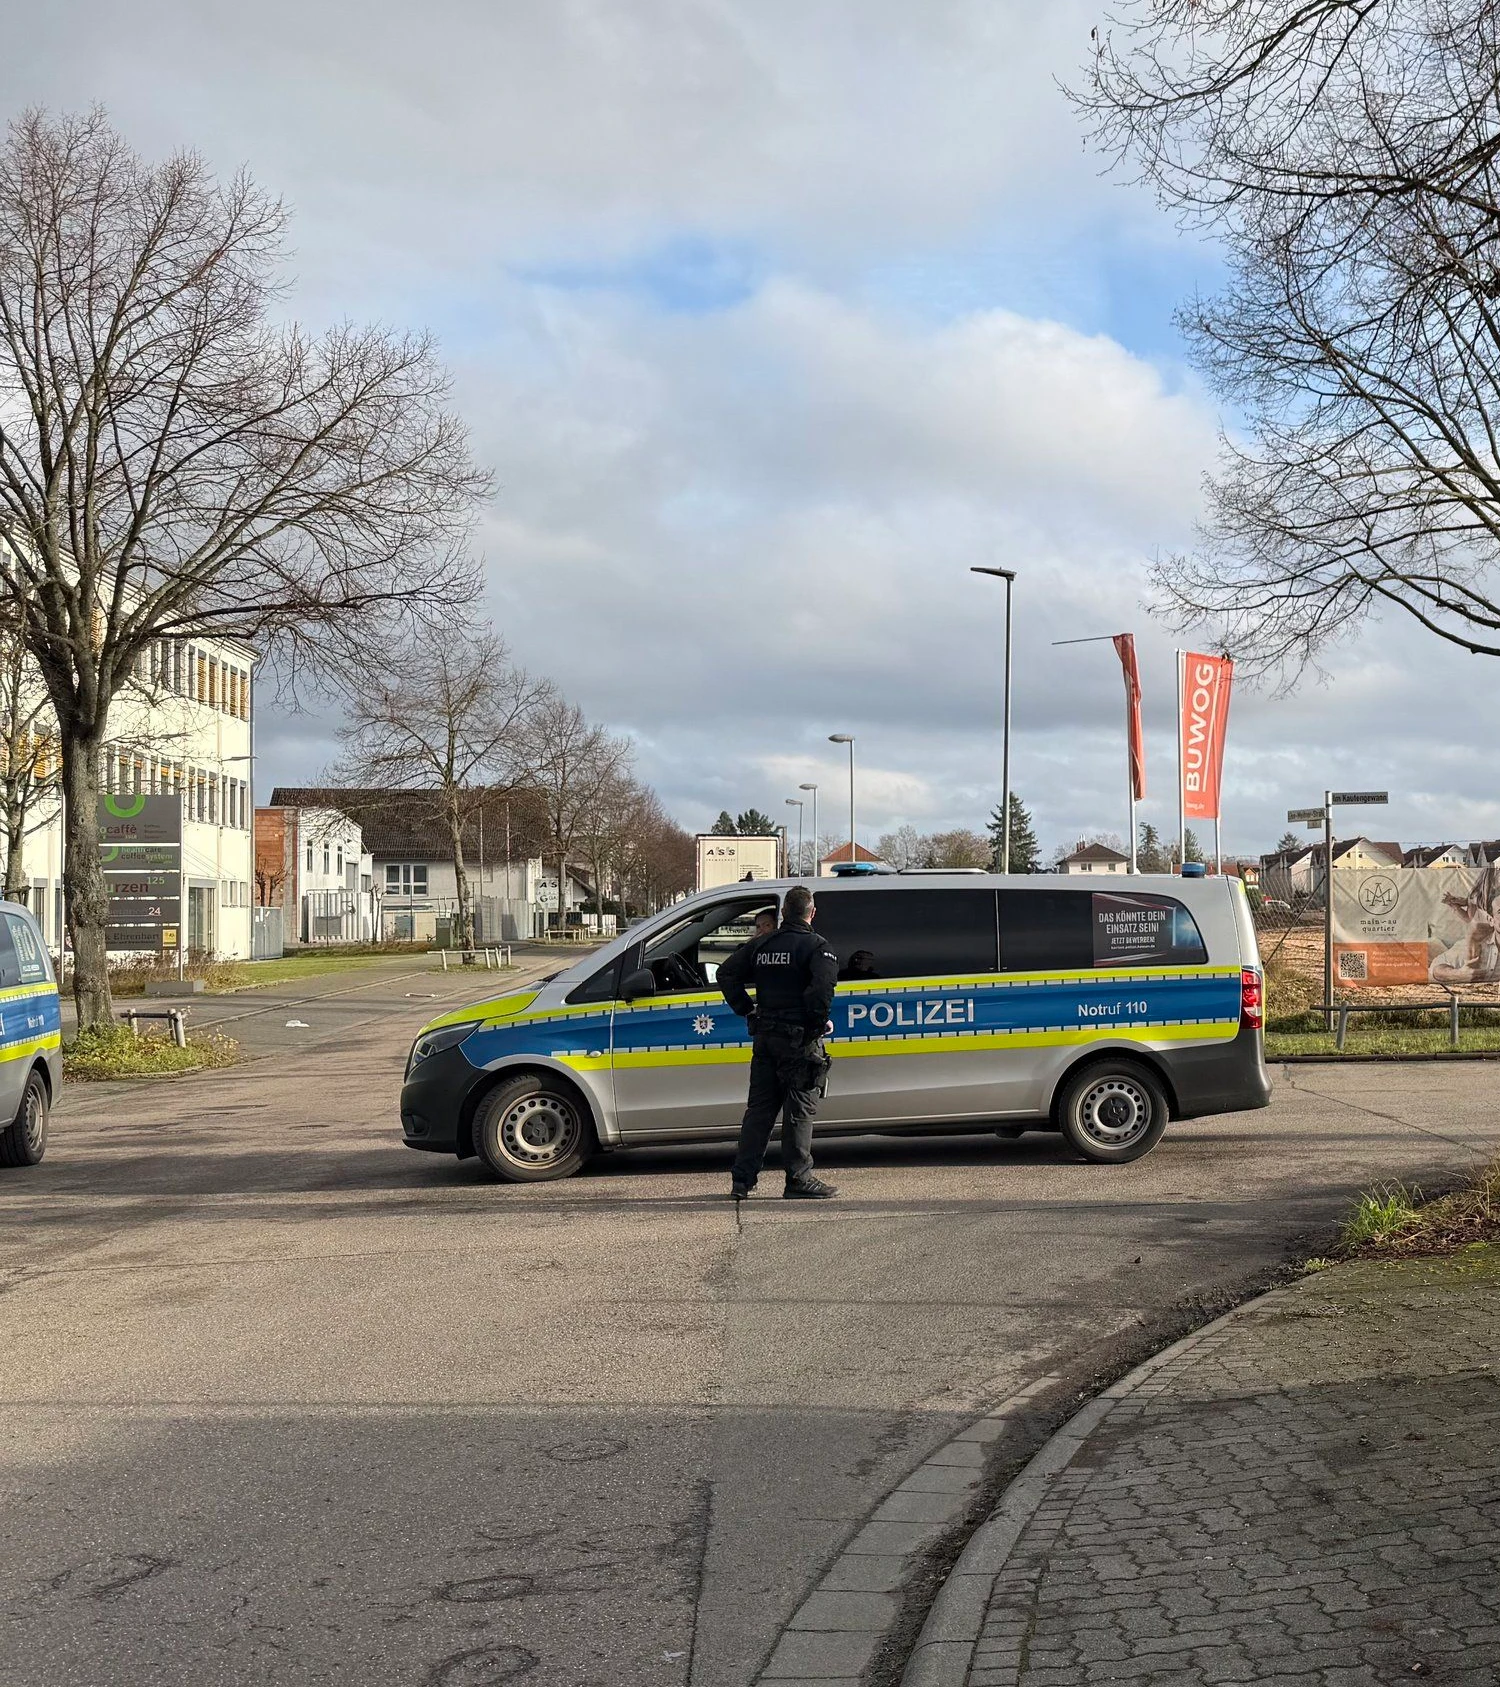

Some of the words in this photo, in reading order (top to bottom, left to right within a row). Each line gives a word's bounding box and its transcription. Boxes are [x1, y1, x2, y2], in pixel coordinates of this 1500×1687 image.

[1186, 663, 1214, 791] BUWOG
[105, 883, 148, 893] urzen
[147, 877, 165, 885] 125
[148, 907, 161, 916] 24
[1098, 913, 1114, 922] DAS
[1115, 910, 1146, 922] KÖNNTE
[1148, 911, 1166, 921] DEIN
[1106, 923, 1137, 934] EINSATZ
[1139, 922, 1159, 932] SEIN!
[1111, 937, 1125, 945] JETZT
[756, 952, 791, 965] POLIZEI
[848, 998, 974, 1028] POLIZEI
[1078, 1002, 1121, 1017] Notruf
[1125, 1001, 1147, 1014] 110
